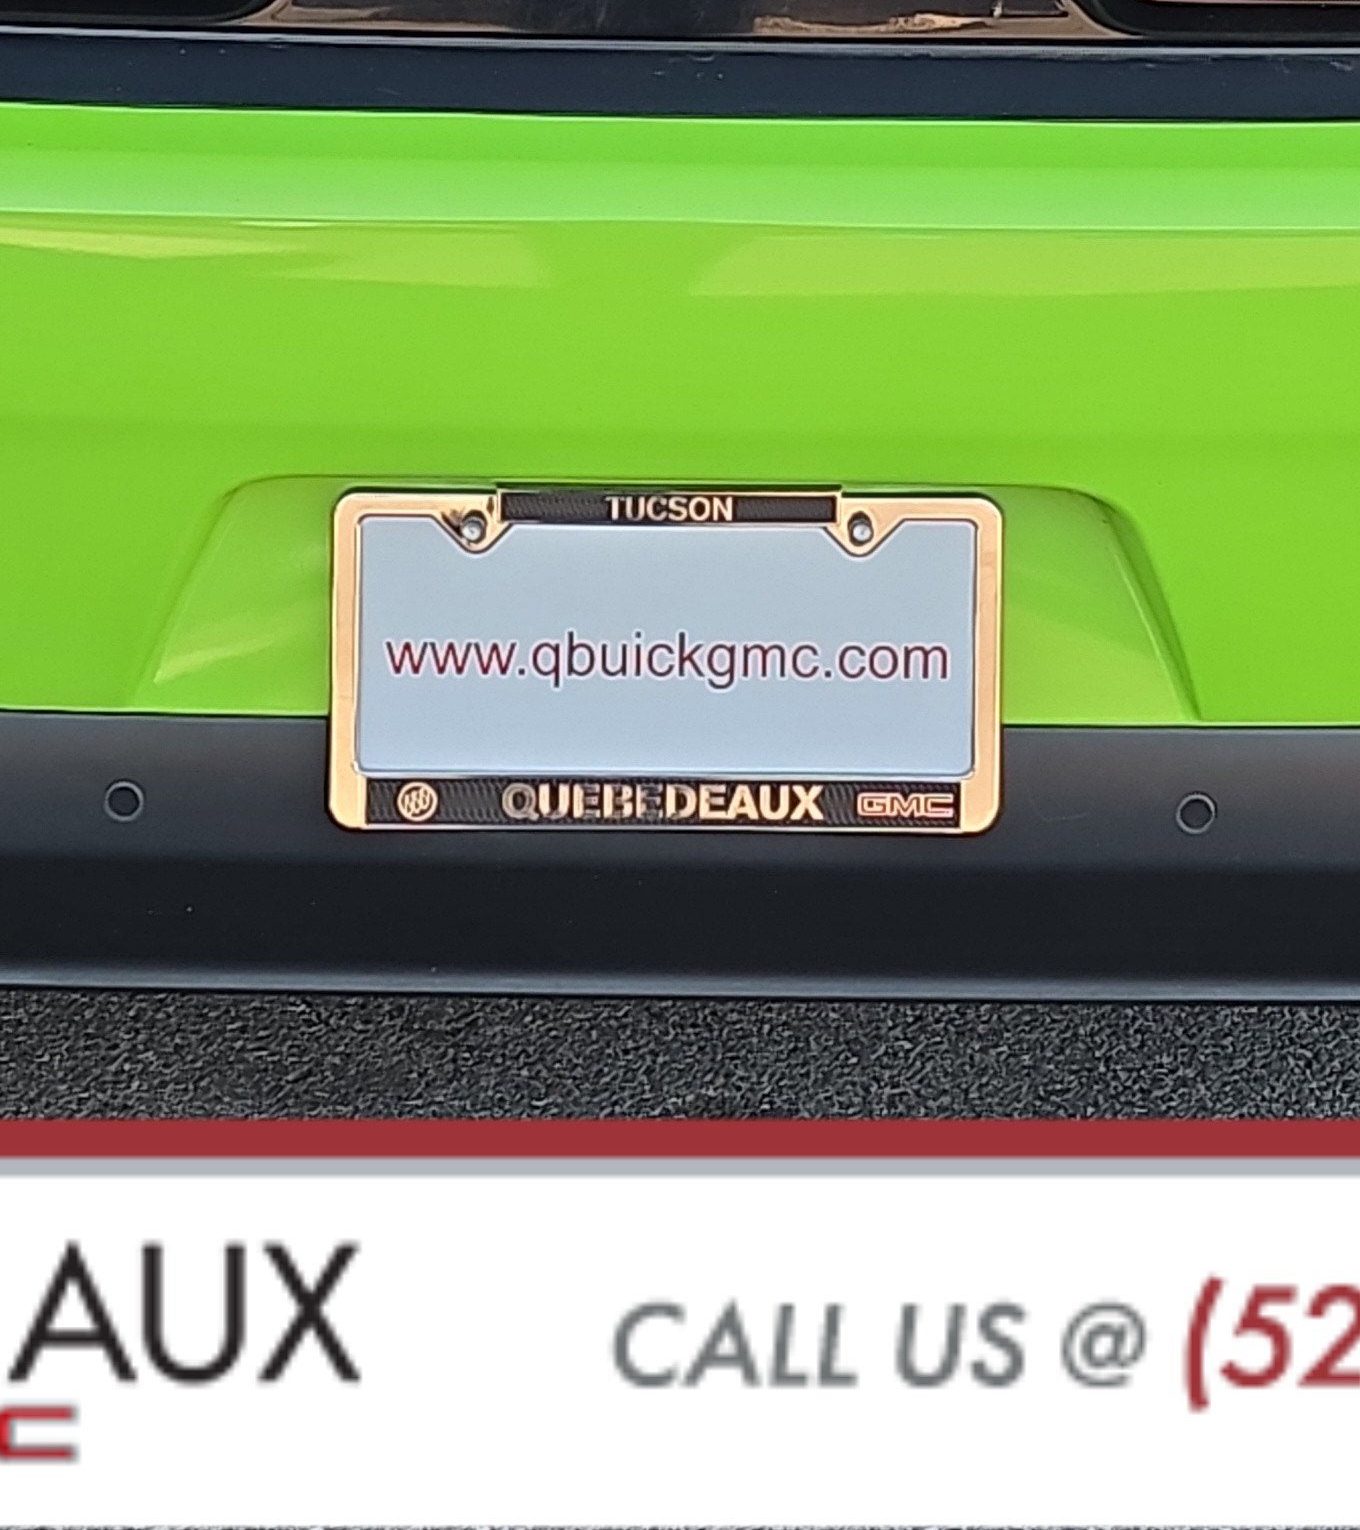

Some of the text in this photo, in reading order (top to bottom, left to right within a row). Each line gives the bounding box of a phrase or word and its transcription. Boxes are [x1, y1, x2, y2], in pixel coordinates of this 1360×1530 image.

[606, 495, 734, 522] TUCSON
[385, 631, 950, 690] www.qbuickgmc.com
[501, 782, 955, 822] QUEBEDEAUX GMC
